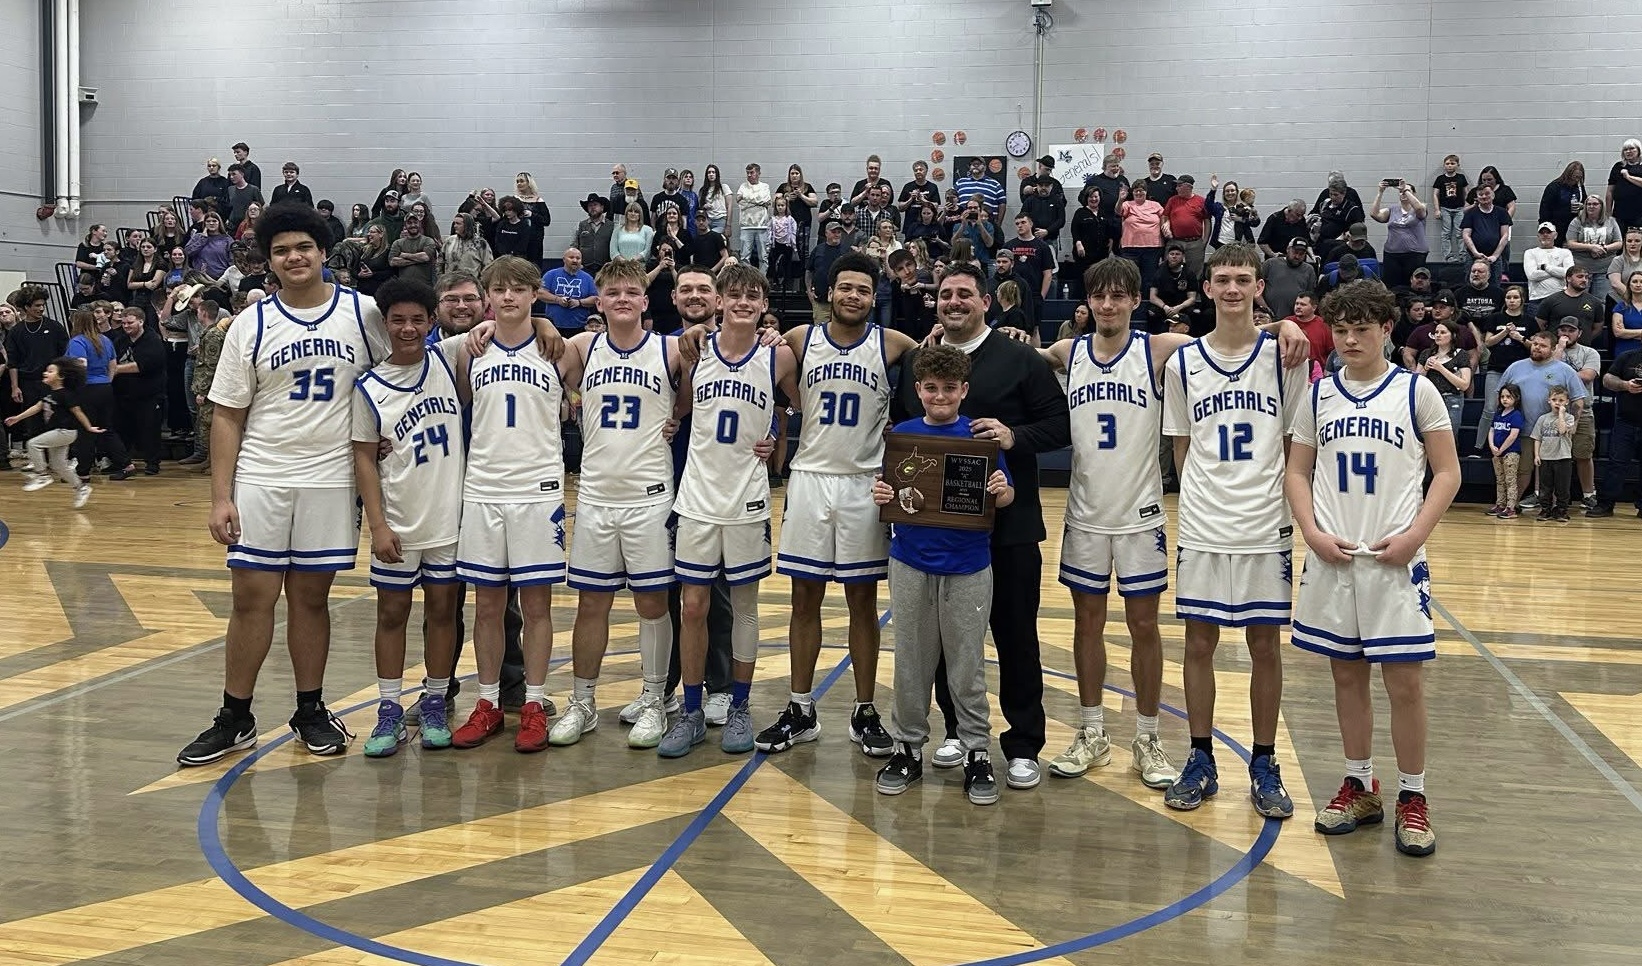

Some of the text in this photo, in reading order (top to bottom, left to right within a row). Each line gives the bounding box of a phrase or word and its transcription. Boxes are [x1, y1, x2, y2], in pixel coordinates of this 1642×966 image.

[270, 338, 355, 370] GENERALS
[289, 367, 335, 401] 35
[474, 363, 550, 392] GENERALS
[586, 366, 661, 395] GENERALS
[807, 362, 879, 392] GENERALS
[504, 393, 516, 428] 1
[696, 379, 767, 410] GENERALS
[818, 391, 861, 427] 30
[1070, 381, 1147, 410] GENERALS
[1193, 390, 1277, 423] GENERALS
[600, 395, 641, 430] 23
[715, 409, 739, 444] 0
[412, 422, 450, 468] 24
[1097, 413, 1117, 450] 3
[1217, 422, 1254, 462] 12
[1319, 416, 1405, 450] GENERALS
[945, 479, 983, 489] BASKETBALL
[1336, 451, 1378, 495] 14
[944, 503, 979, 511] CHAMPION
[947, 496, 978, 505] REGIONAL
